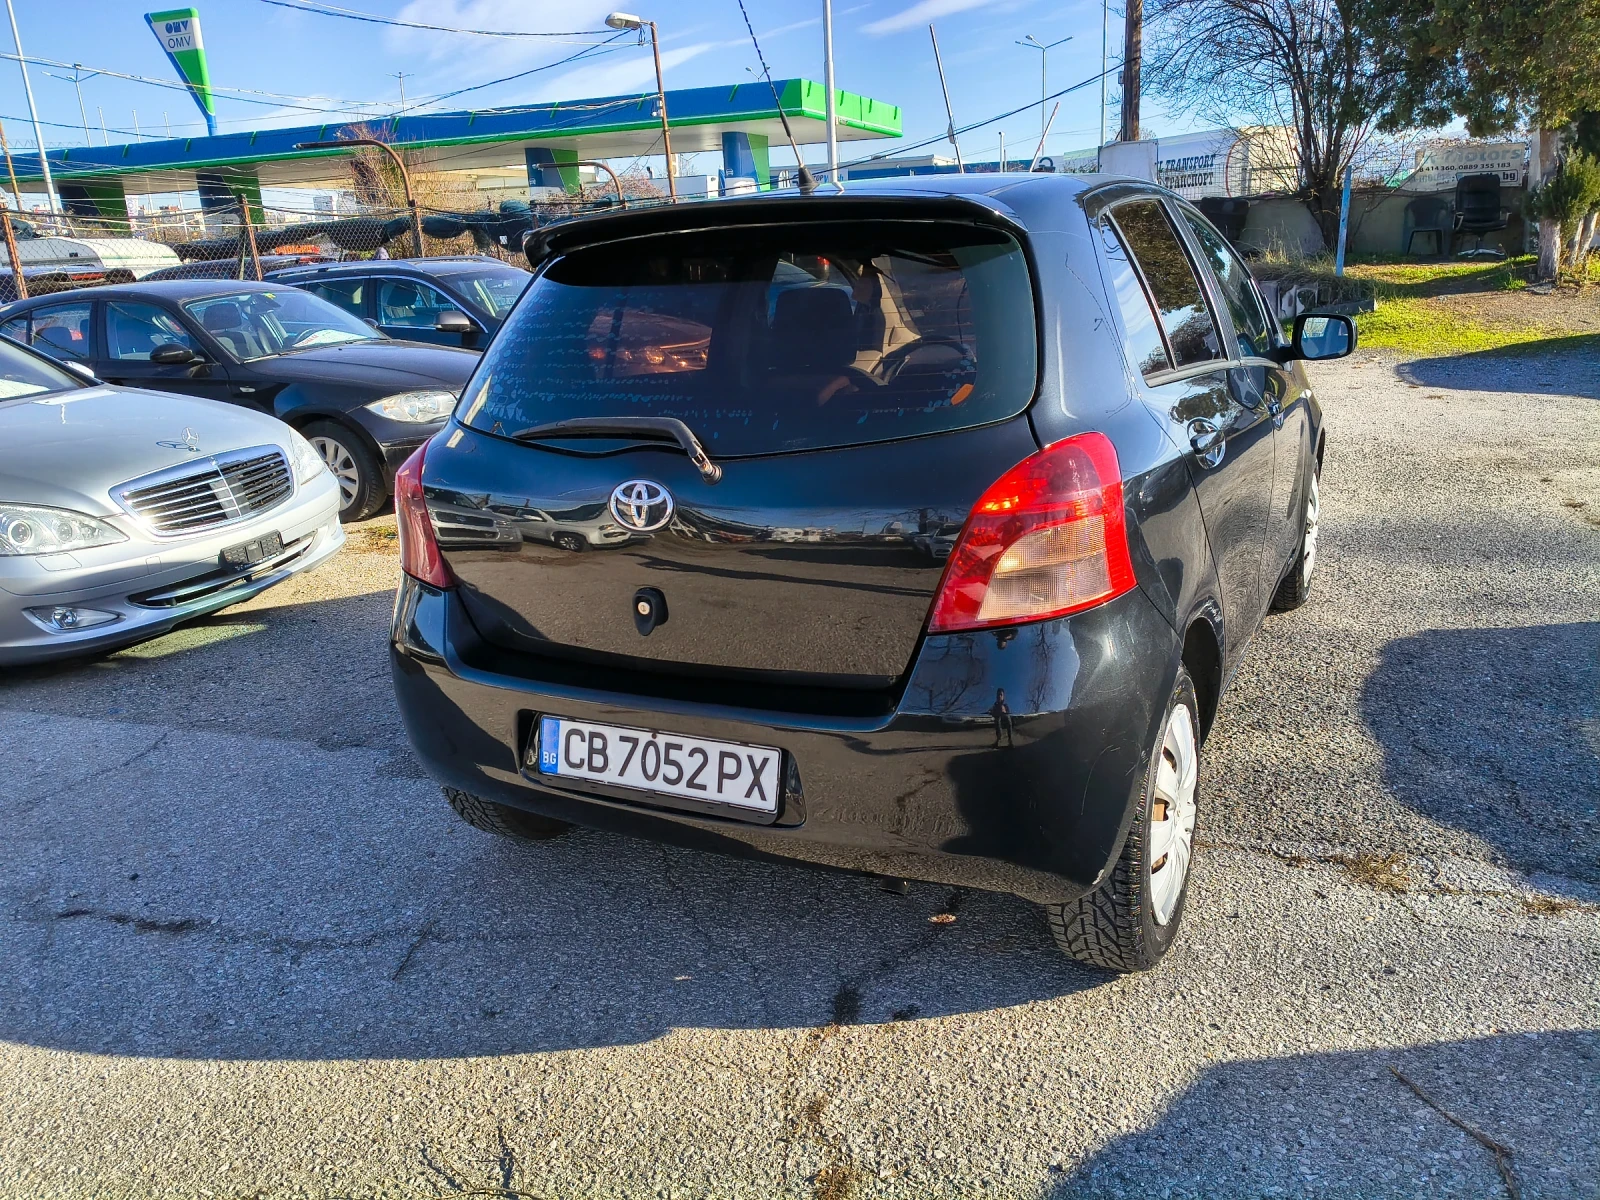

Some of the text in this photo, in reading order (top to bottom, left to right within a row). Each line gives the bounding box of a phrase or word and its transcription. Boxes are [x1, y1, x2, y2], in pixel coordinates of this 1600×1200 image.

[168, 35, 191, 49] OMV
[1166, 153, 1216, 171] TRANSPORT
[542, 751, 557, 765] BG
